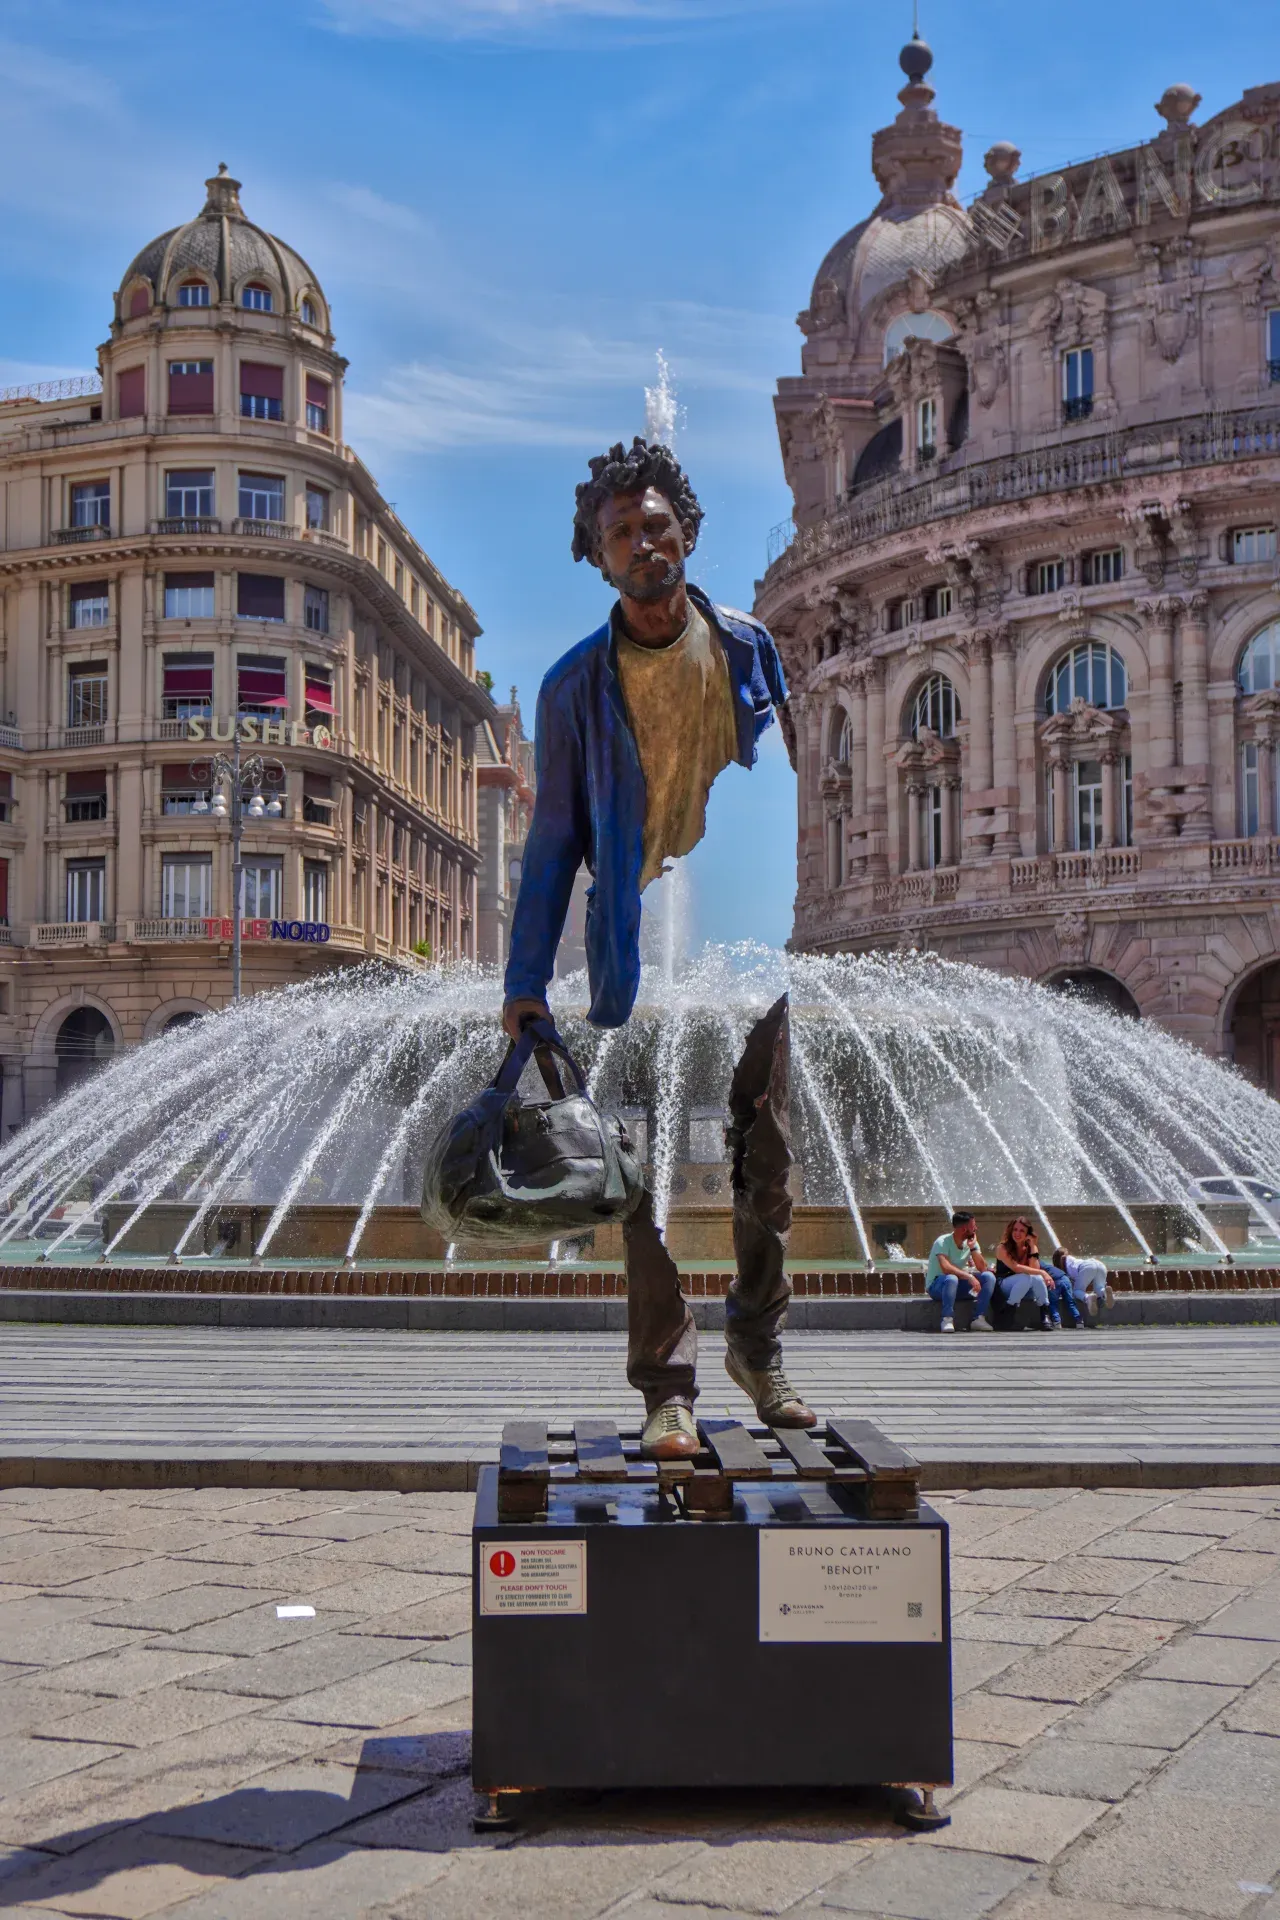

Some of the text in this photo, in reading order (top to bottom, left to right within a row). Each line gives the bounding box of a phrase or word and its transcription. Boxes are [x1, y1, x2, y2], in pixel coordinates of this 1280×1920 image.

[1030, 121, 1280, 253] BANC
[187, 715, 297, 747] SUSHI
[789, 1546, 912, 1557] BRUNO CATALANO
[821, 1565, 880, 1575] "BENOIT"
